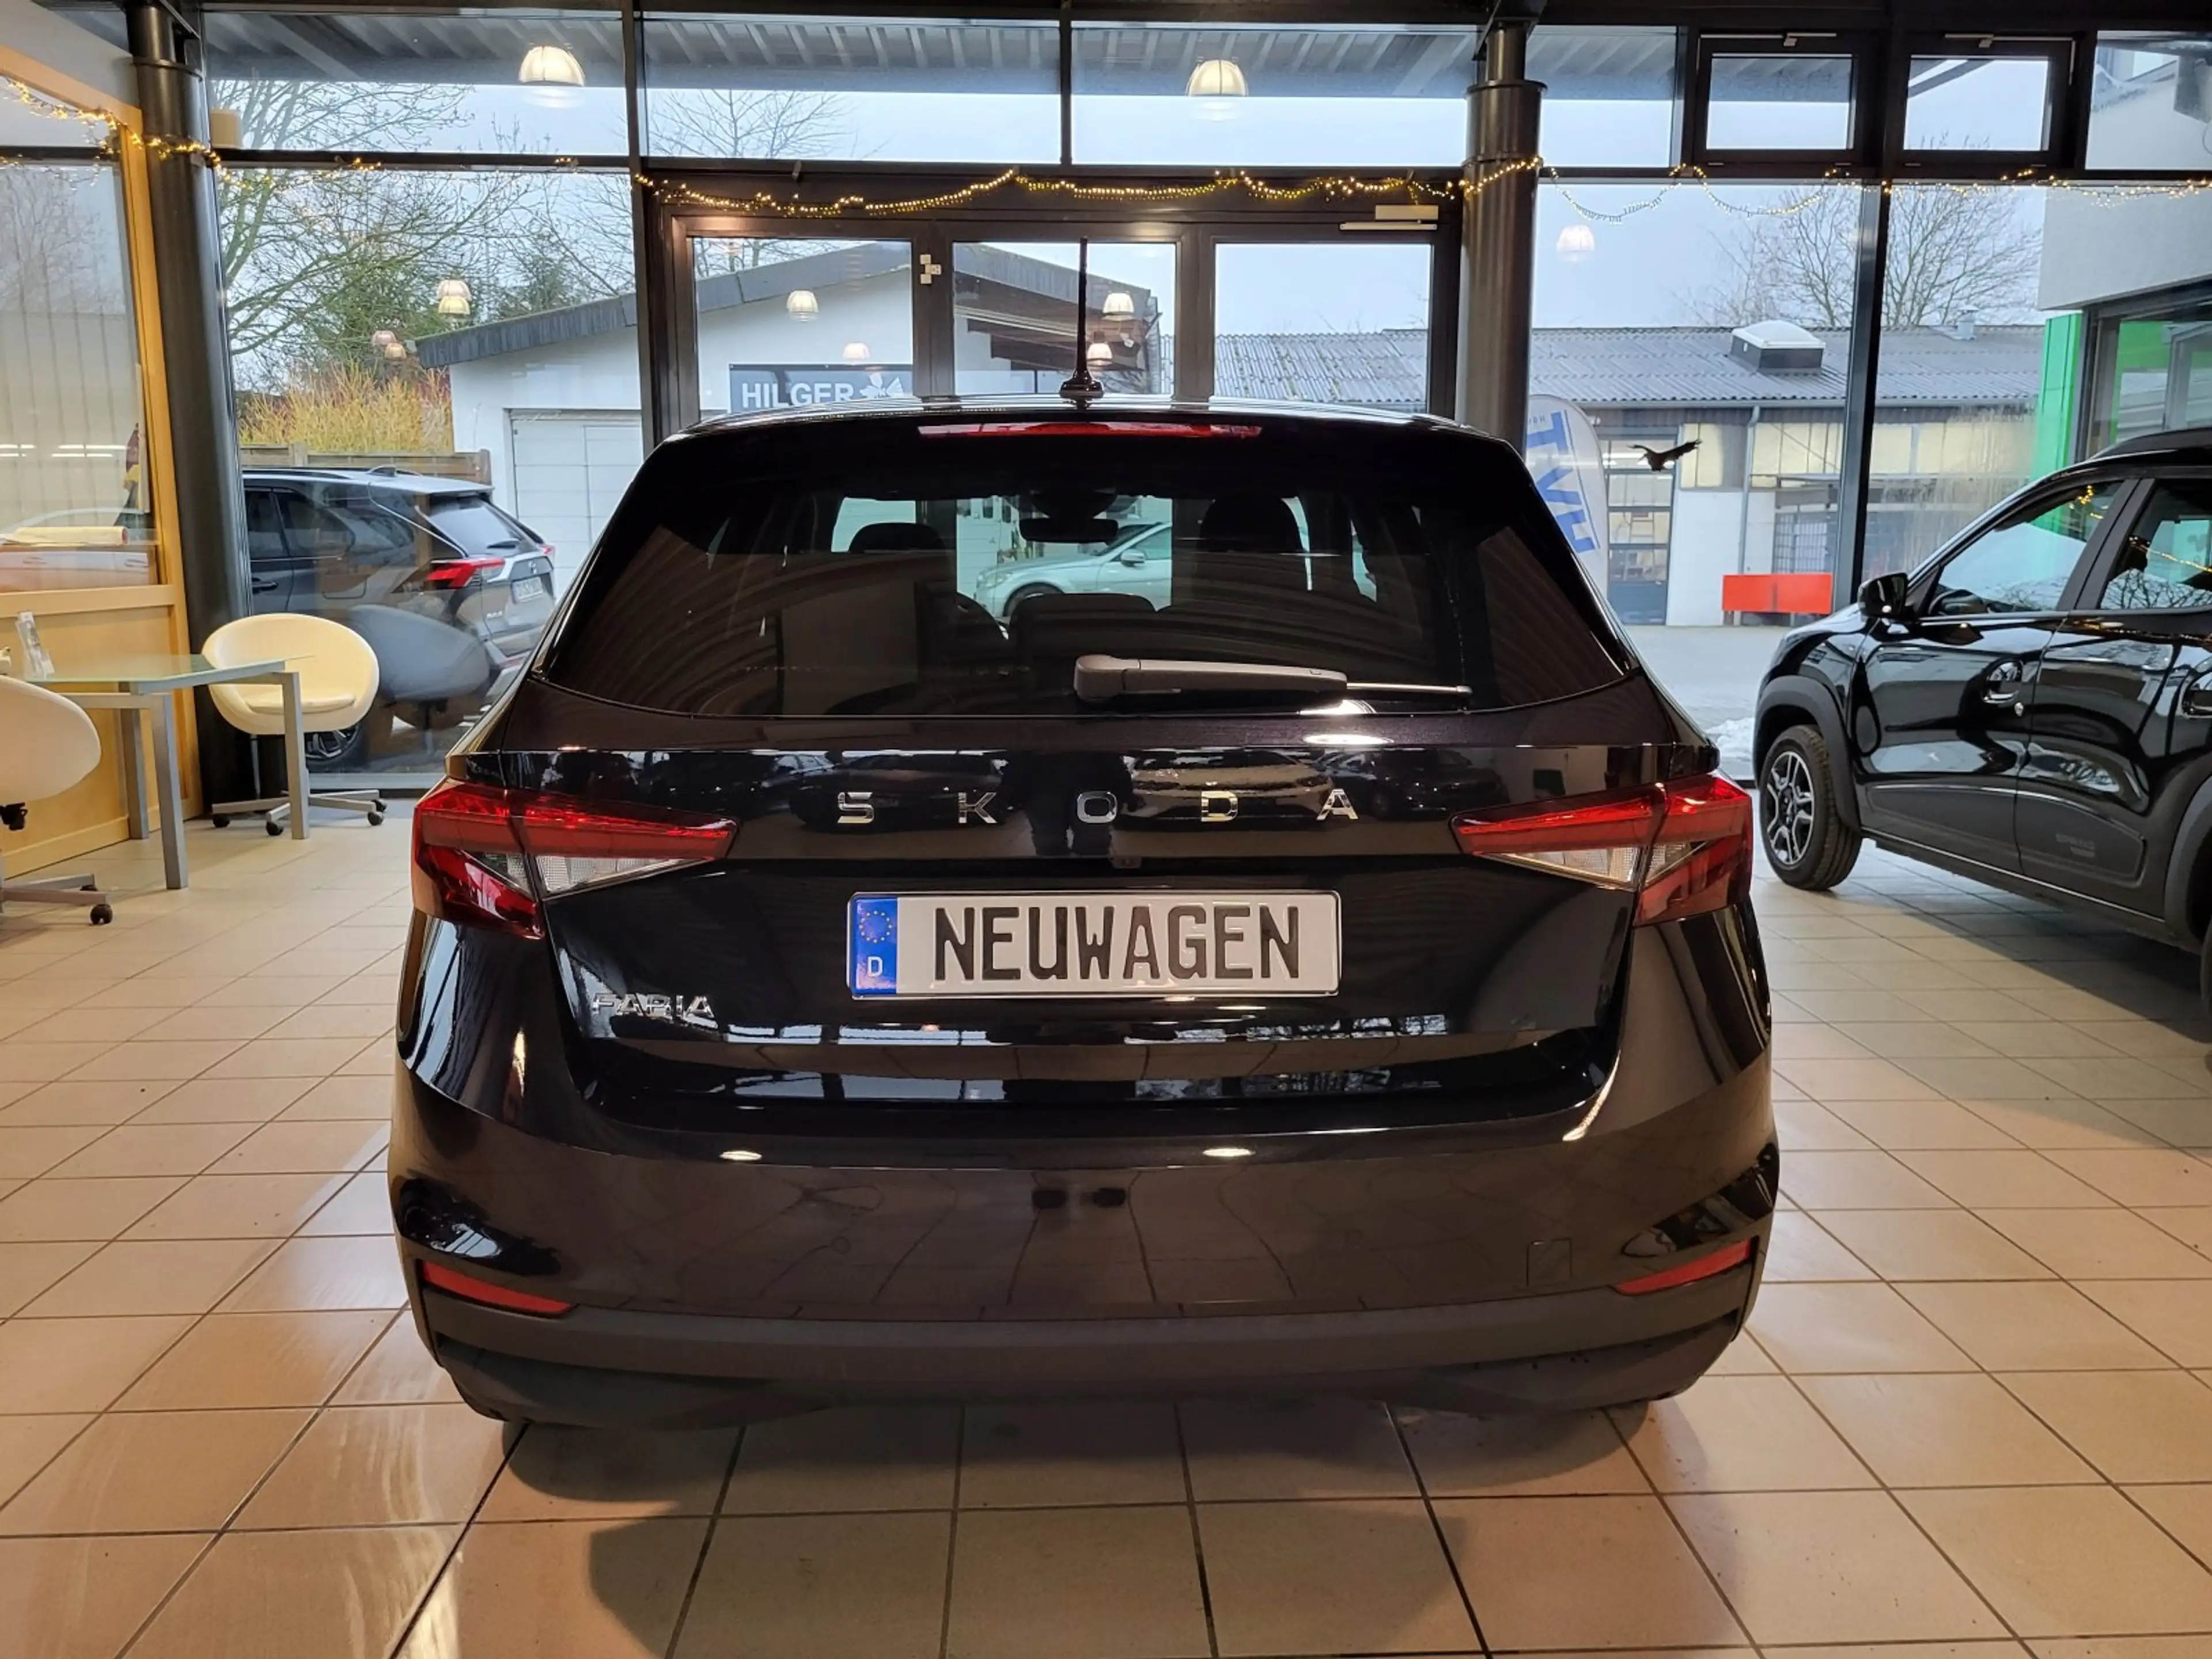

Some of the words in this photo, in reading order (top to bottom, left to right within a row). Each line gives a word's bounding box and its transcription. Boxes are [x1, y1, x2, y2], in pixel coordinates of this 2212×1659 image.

[743, 382, 854, 408] HILGER
[836, 787, 1359, 824] SKODA
[868, 957, 883, 977] D
[934, 906, 1300, 980] NEUWAGEN
[593, 993, 715, 1021] FABIA
